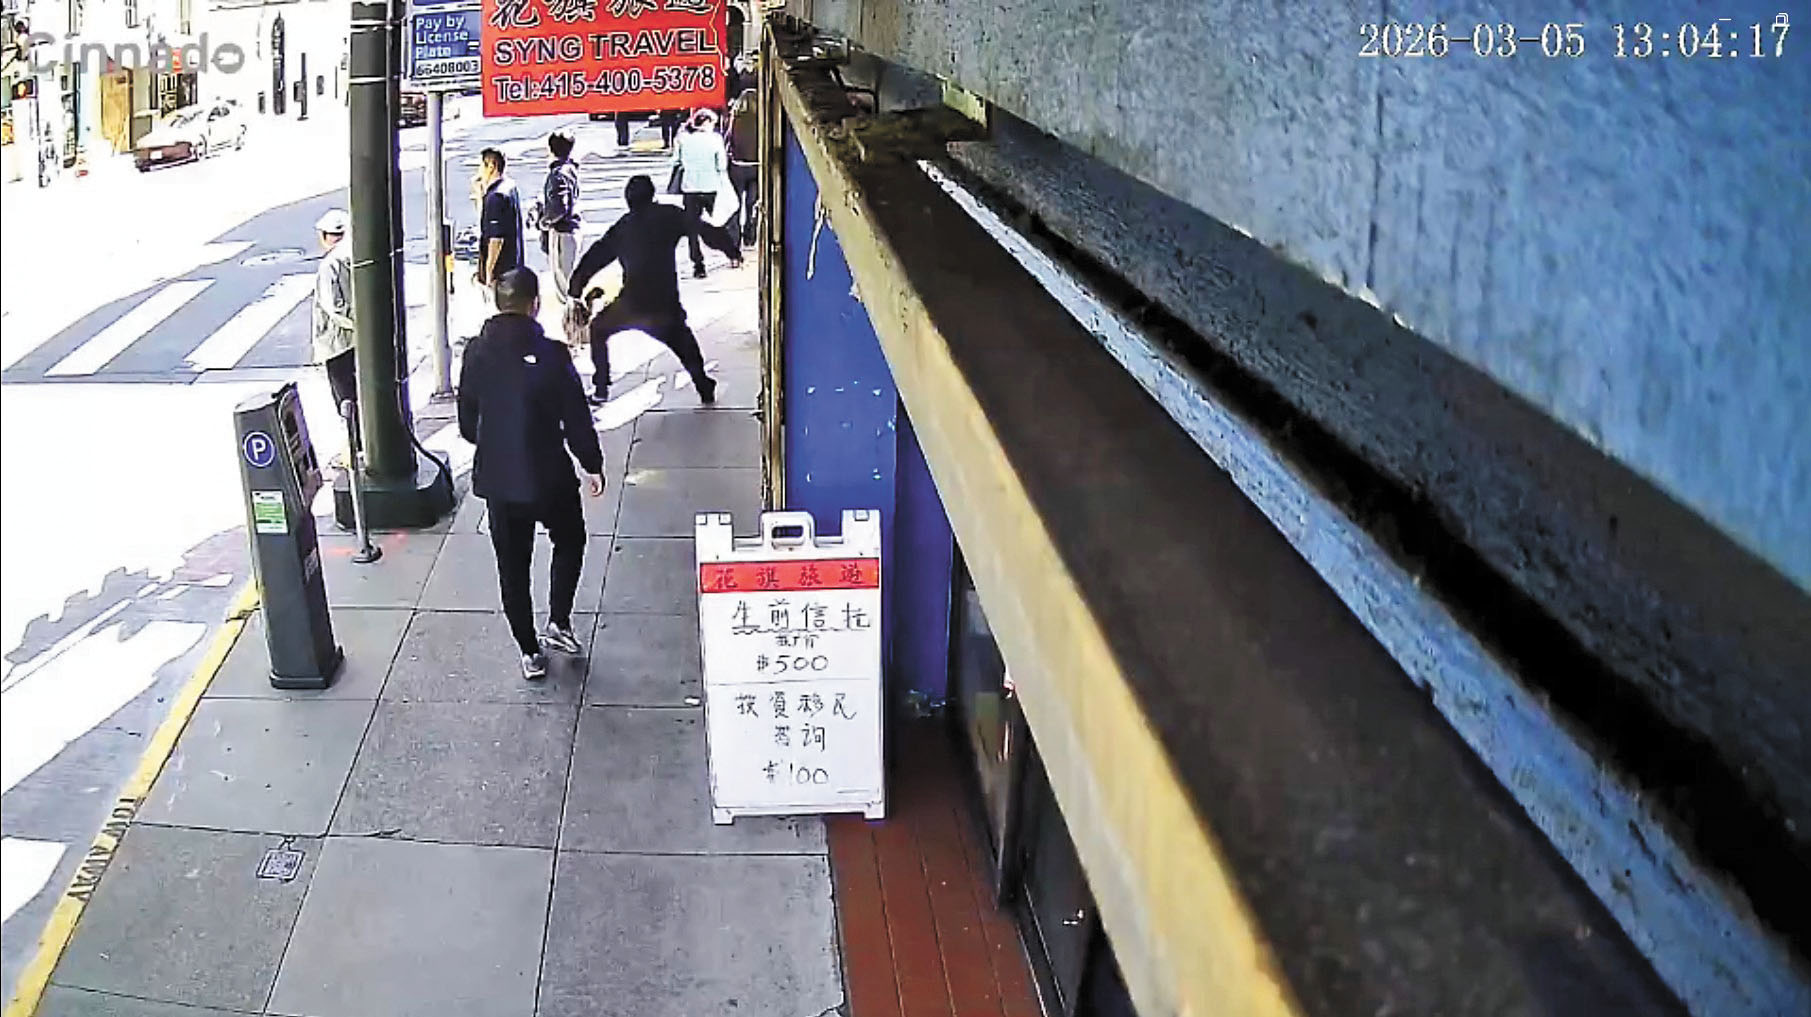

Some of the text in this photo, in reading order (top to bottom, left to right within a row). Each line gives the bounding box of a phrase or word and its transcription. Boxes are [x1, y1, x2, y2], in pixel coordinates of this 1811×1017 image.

[415, 14, 465, 32] Pay by
[415, 30, 469, 44] License
[494, 28, 718, 65] SYNG TRAVEL
[492, 64, 716, 102] Tel:415-400-5378
[251, 438, 266, 460] P
[756, 653, 829, 674] $500
